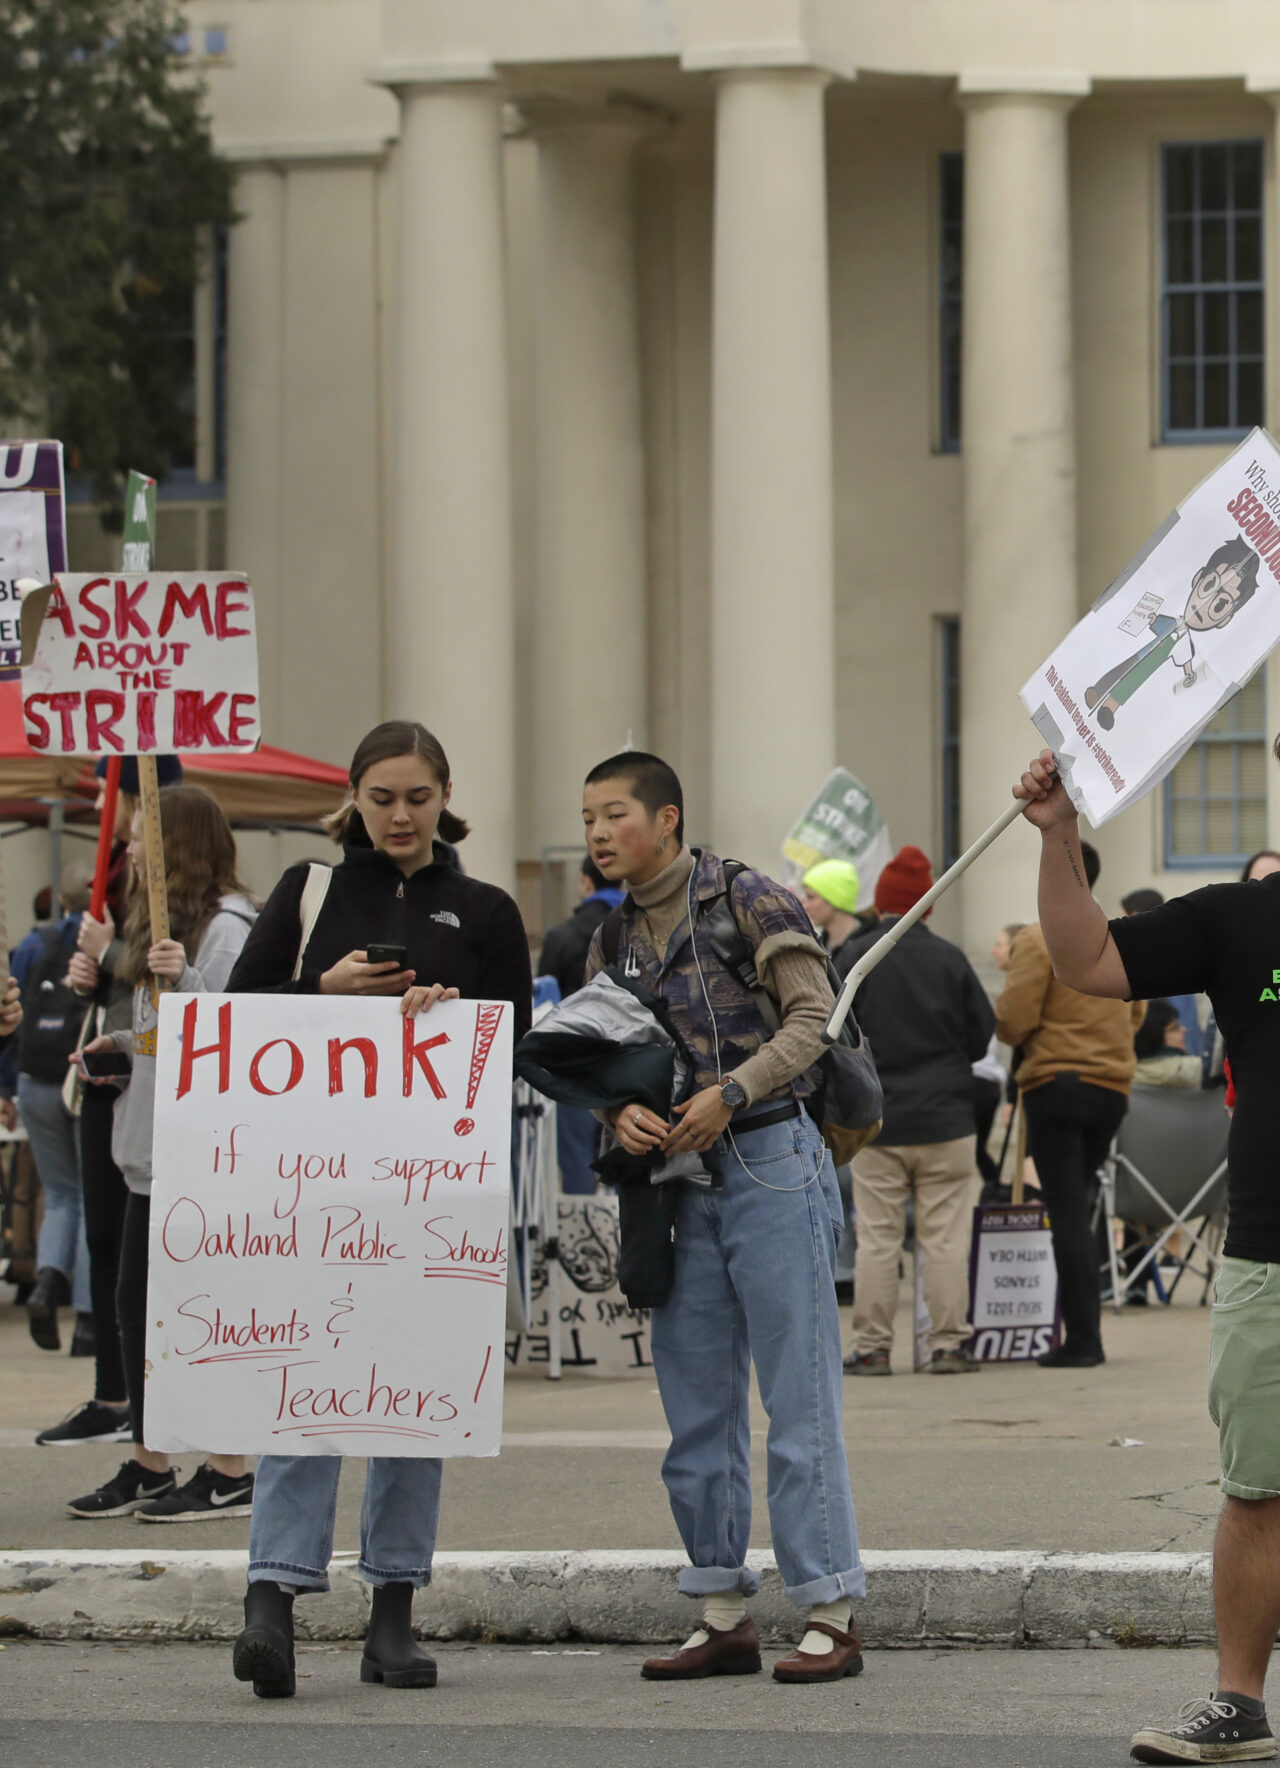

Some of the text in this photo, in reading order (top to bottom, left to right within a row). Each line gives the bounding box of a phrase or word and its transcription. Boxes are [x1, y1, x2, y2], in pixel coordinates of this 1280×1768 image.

[1244, 459, 1269, 494] Why
[44, 577, 251, 641] ASK ME
[74, 641, 191, 670] ABOUT
[116, 669, 172, 691] THE
[24, 689, 256, 752] STRIKE
[1045, 664, 1059, 687] This
[1053, 680, 1077, 715] Oakland
[1085, 731, 1097, 748] is
[1091, 743, 1126, 794] #strikeready
[175, 998, 505, 1136] Honk!
[213, 1124, 496, 1219] if you support
[163, 1197, 508, 1266] Oakland Public Schools
[1008, 1214, 1039, 1226] LOCAL
[989, 1249, 1048, 1262] WITH OEA
[995, 1275, 1040, 1290] STANDS
[175, 1294, 310, 1356] Students
[1018, 1301, 1042, 1315] SEIU
[974, 1327, 1053, 1360] SEIU
